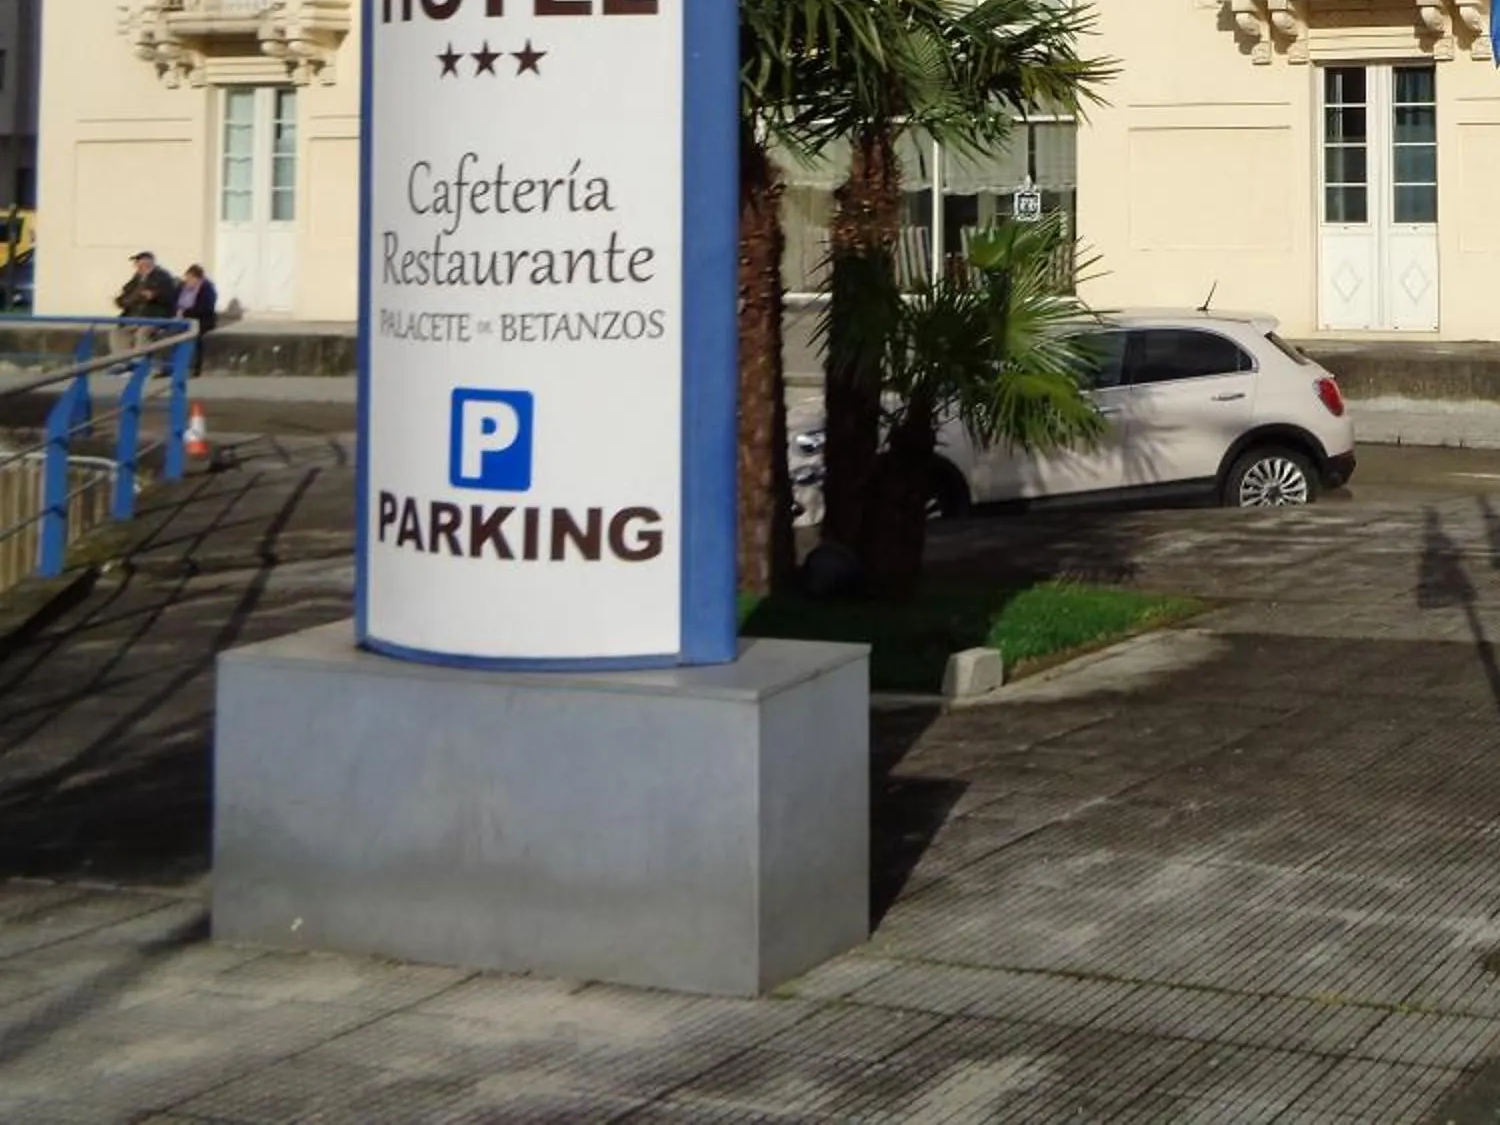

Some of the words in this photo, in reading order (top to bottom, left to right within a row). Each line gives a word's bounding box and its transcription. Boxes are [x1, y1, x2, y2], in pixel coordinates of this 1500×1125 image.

[407, 152, 616, 236] Cafetería
[382, 231, 656, 287] Restaurante
[379, 308, 470, 343] PALACETE
[501, 309, 665, 342] BETANZOS
[460, 399, 520, 479] P
[379, 490, 664, 562] PARKING
